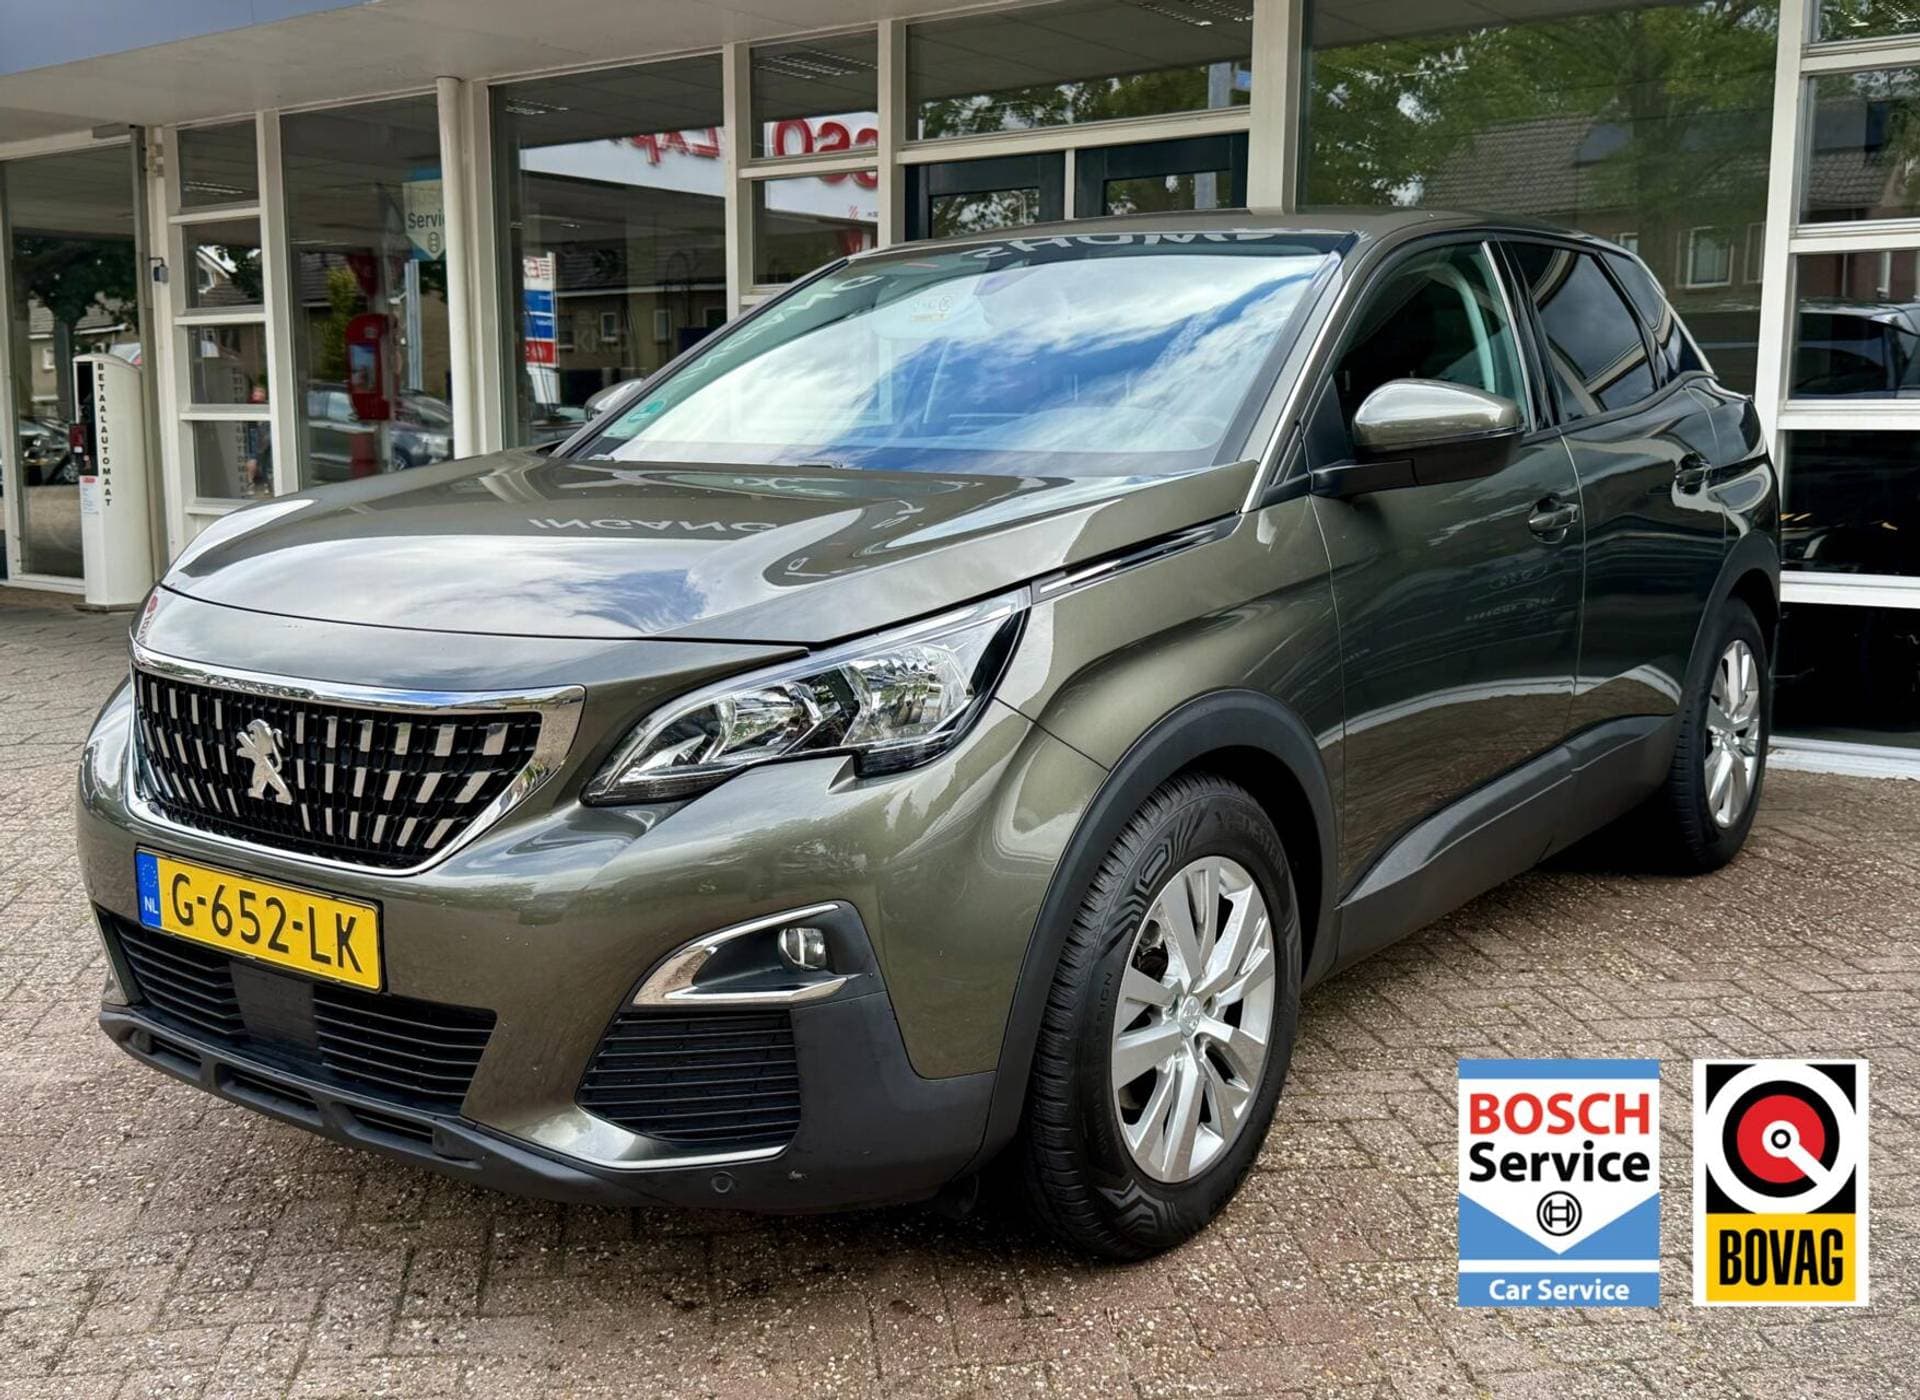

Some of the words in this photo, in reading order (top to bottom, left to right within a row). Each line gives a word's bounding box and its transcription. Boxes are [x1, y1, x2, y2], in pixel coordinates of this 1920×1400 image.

[97, 363, 113, 506] BETAALAUTOMAAT
[144, 896, 159, 915] NL
[171, 873, 363, 973] G-652-LK
